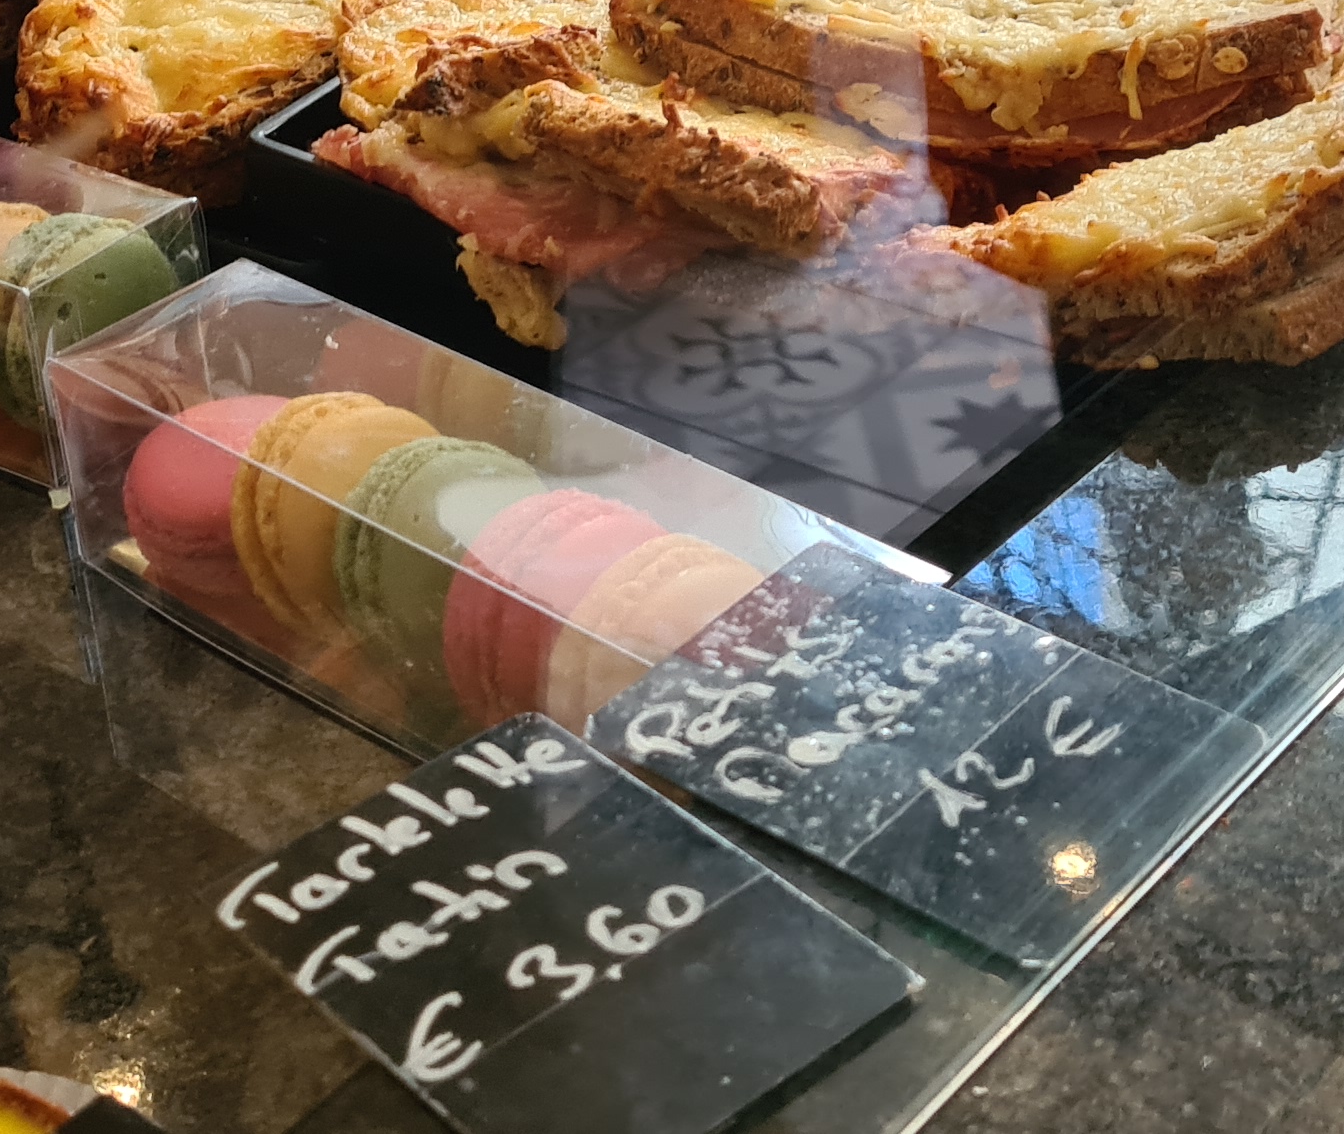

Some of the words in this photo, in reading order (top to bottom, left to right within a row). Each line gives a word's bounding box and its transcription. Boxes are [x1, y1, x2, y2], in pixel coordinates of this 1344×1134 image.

[918, 751, 1034, 827] 12
[294, 849, 569, 995] Tatin
[402, 991, 483, 1083] €
[506, 884, 706, 1000] 3.60
